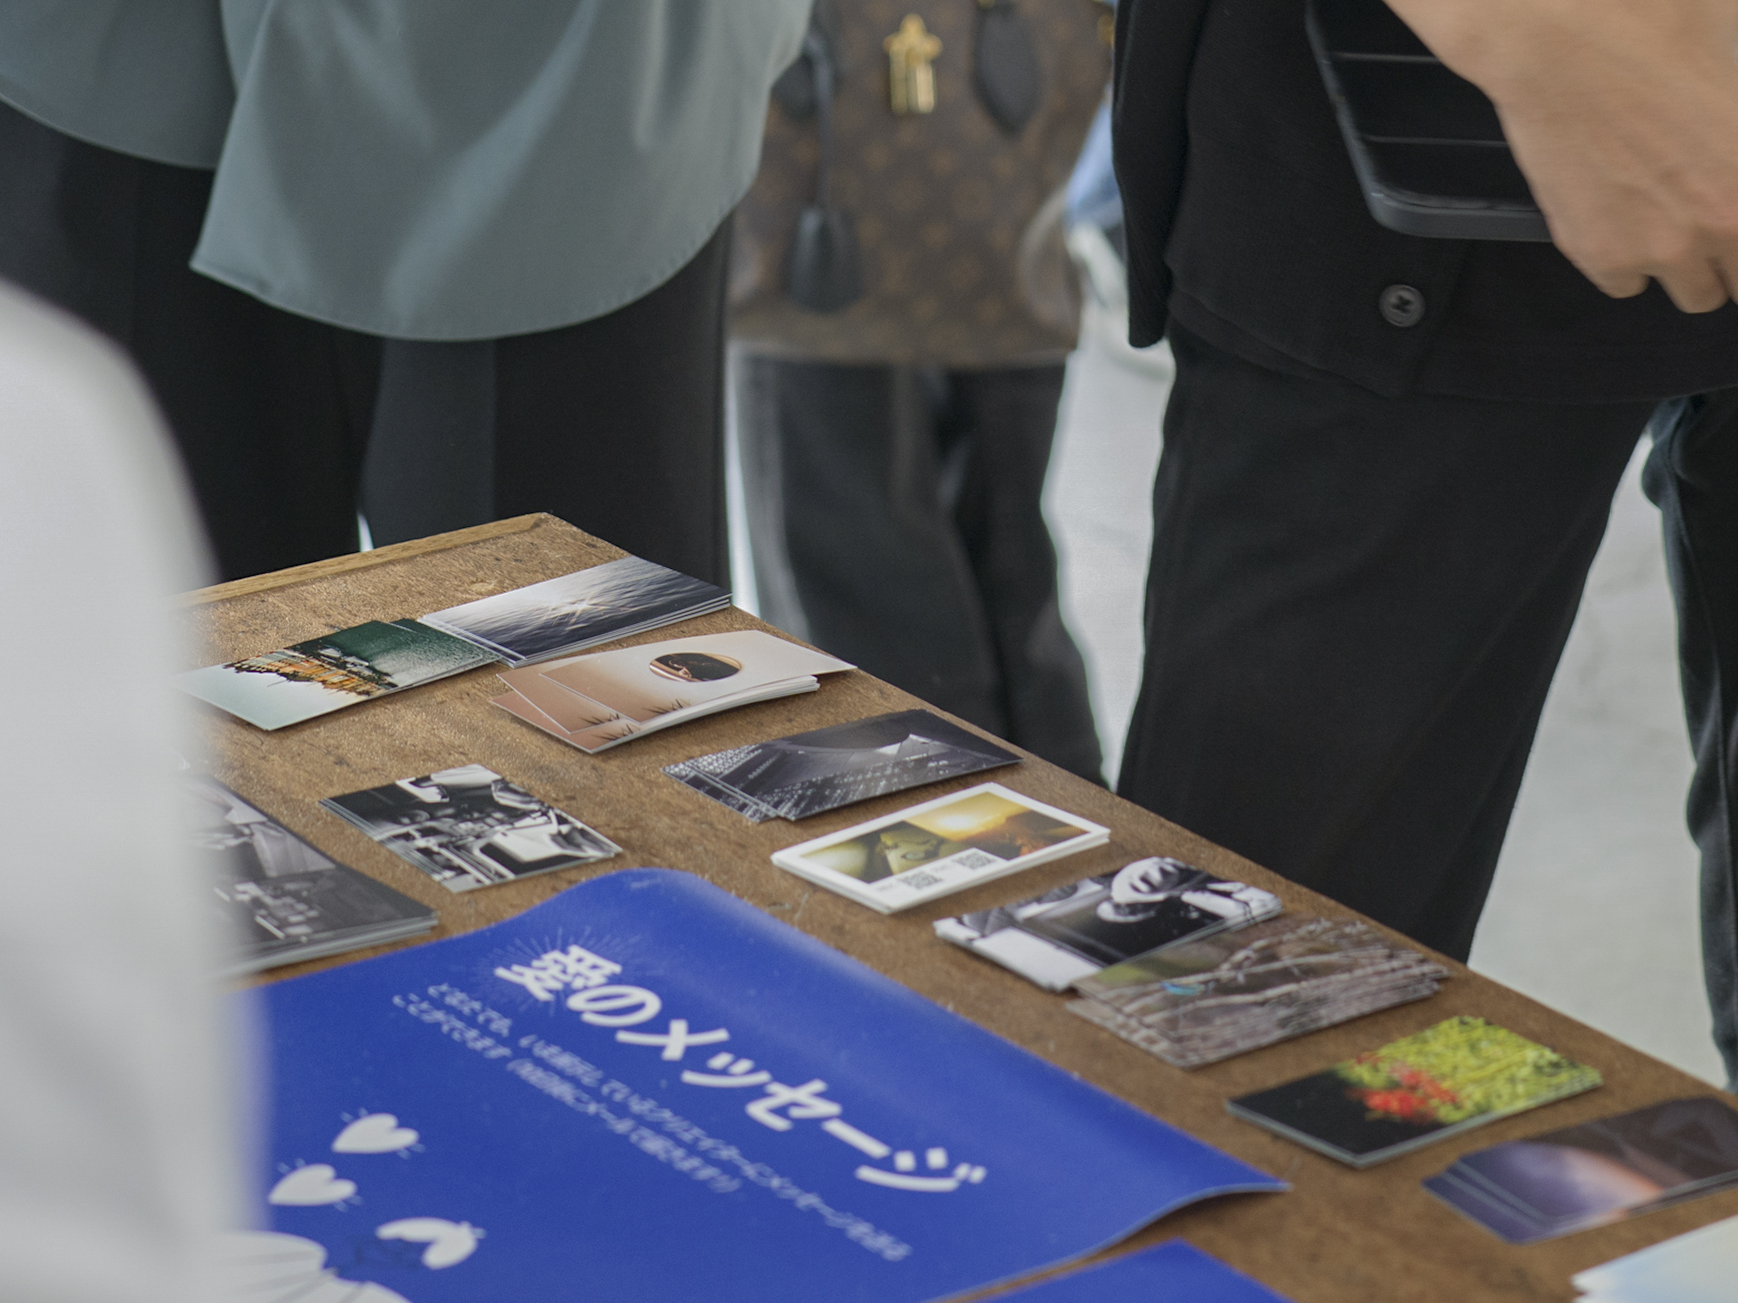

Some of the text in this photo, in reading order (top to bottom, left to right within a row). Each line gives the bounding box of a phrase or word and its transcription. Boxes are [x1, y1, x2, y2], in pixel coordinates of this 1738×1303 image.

[495, 943, 987, 1192] 愛のメッセージ
